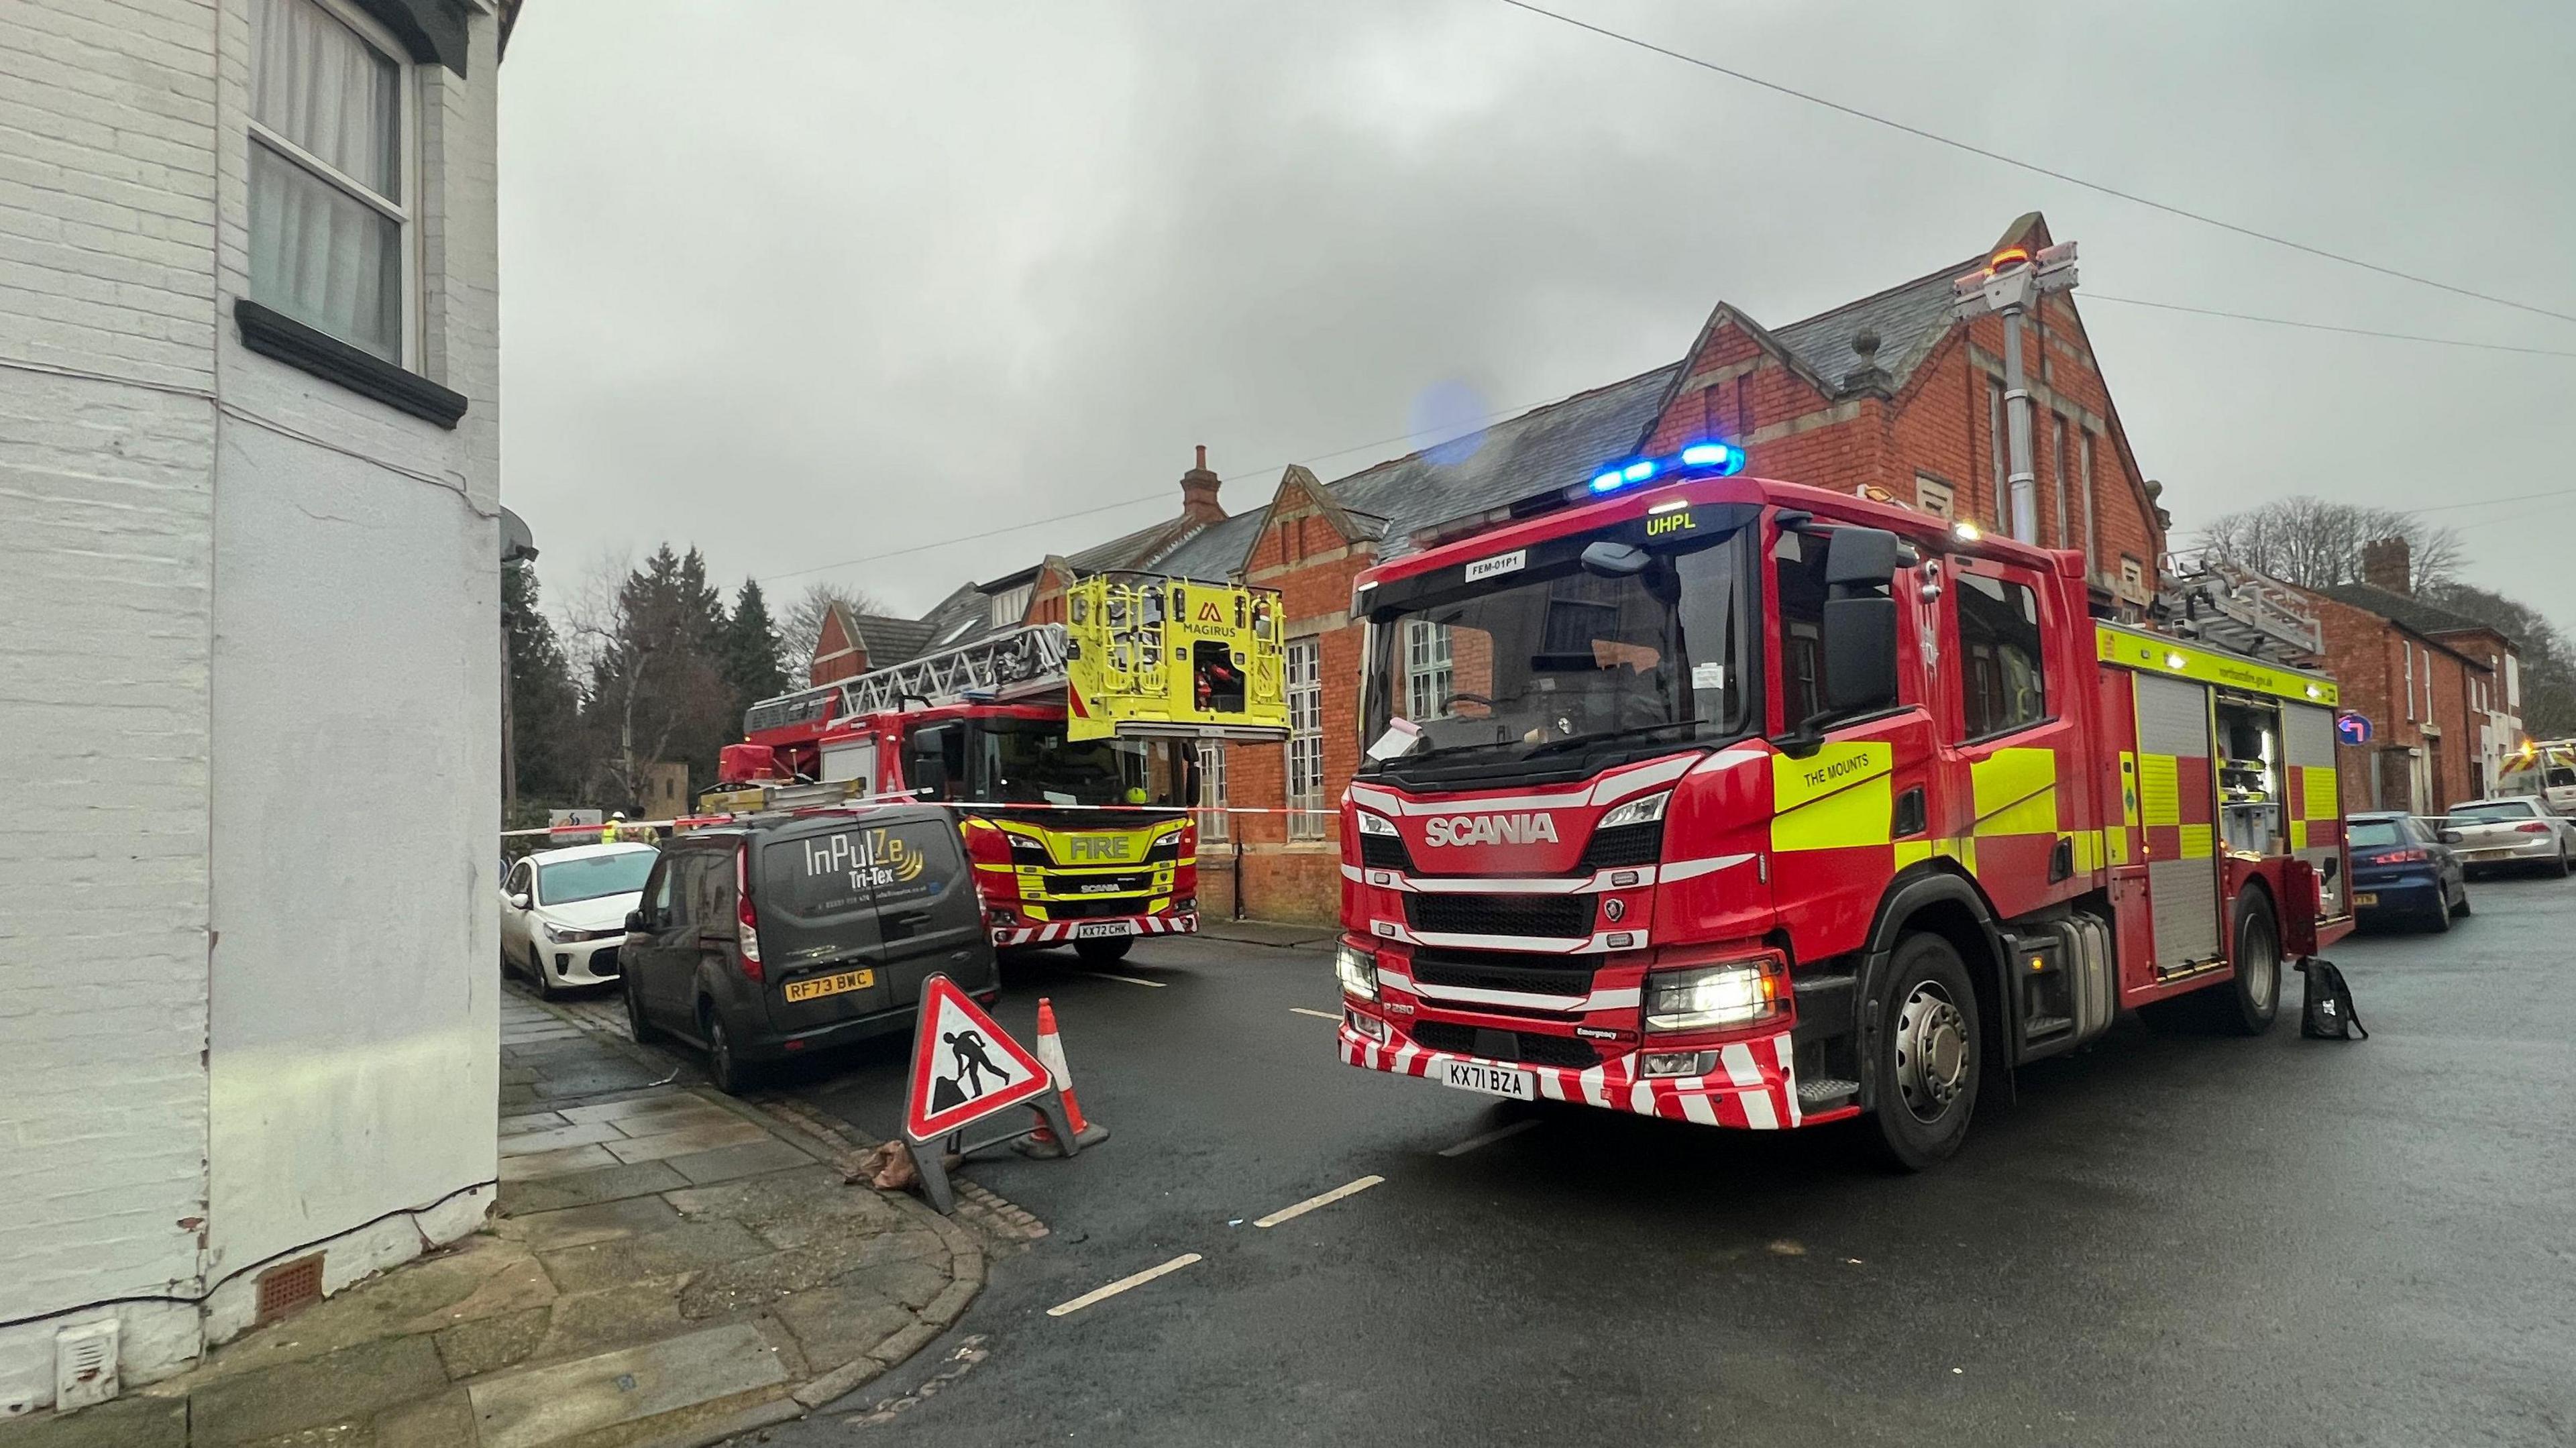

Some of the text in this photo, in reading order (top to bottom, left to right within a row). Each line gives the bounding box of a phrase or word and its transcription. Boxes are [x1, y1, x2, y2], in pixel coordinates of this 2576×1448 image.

[1647, 513, 1696, 536] UHPL
[1472, 557, 1517, 575] FEM-01P1
[1183, 623, 1236, 637] MAGIRUS
[1803, 753, 1869, 787] THE MOUNTS
[1425, 812, 1559, 847] SCANIA
[805, 828, 904, 877] InPulZe
[1071, 836, 1130, 859] FIRE
[849, 867, 894, 889] Tri-Tex
[1081, 883, 1120, 893] SCANIA
[1082, 925, 1127, 936] KX72 CHK
[791, 972, 867, 999] RF73 BWC
[1450, 1064, 1522, 1095] KX71 BZA
